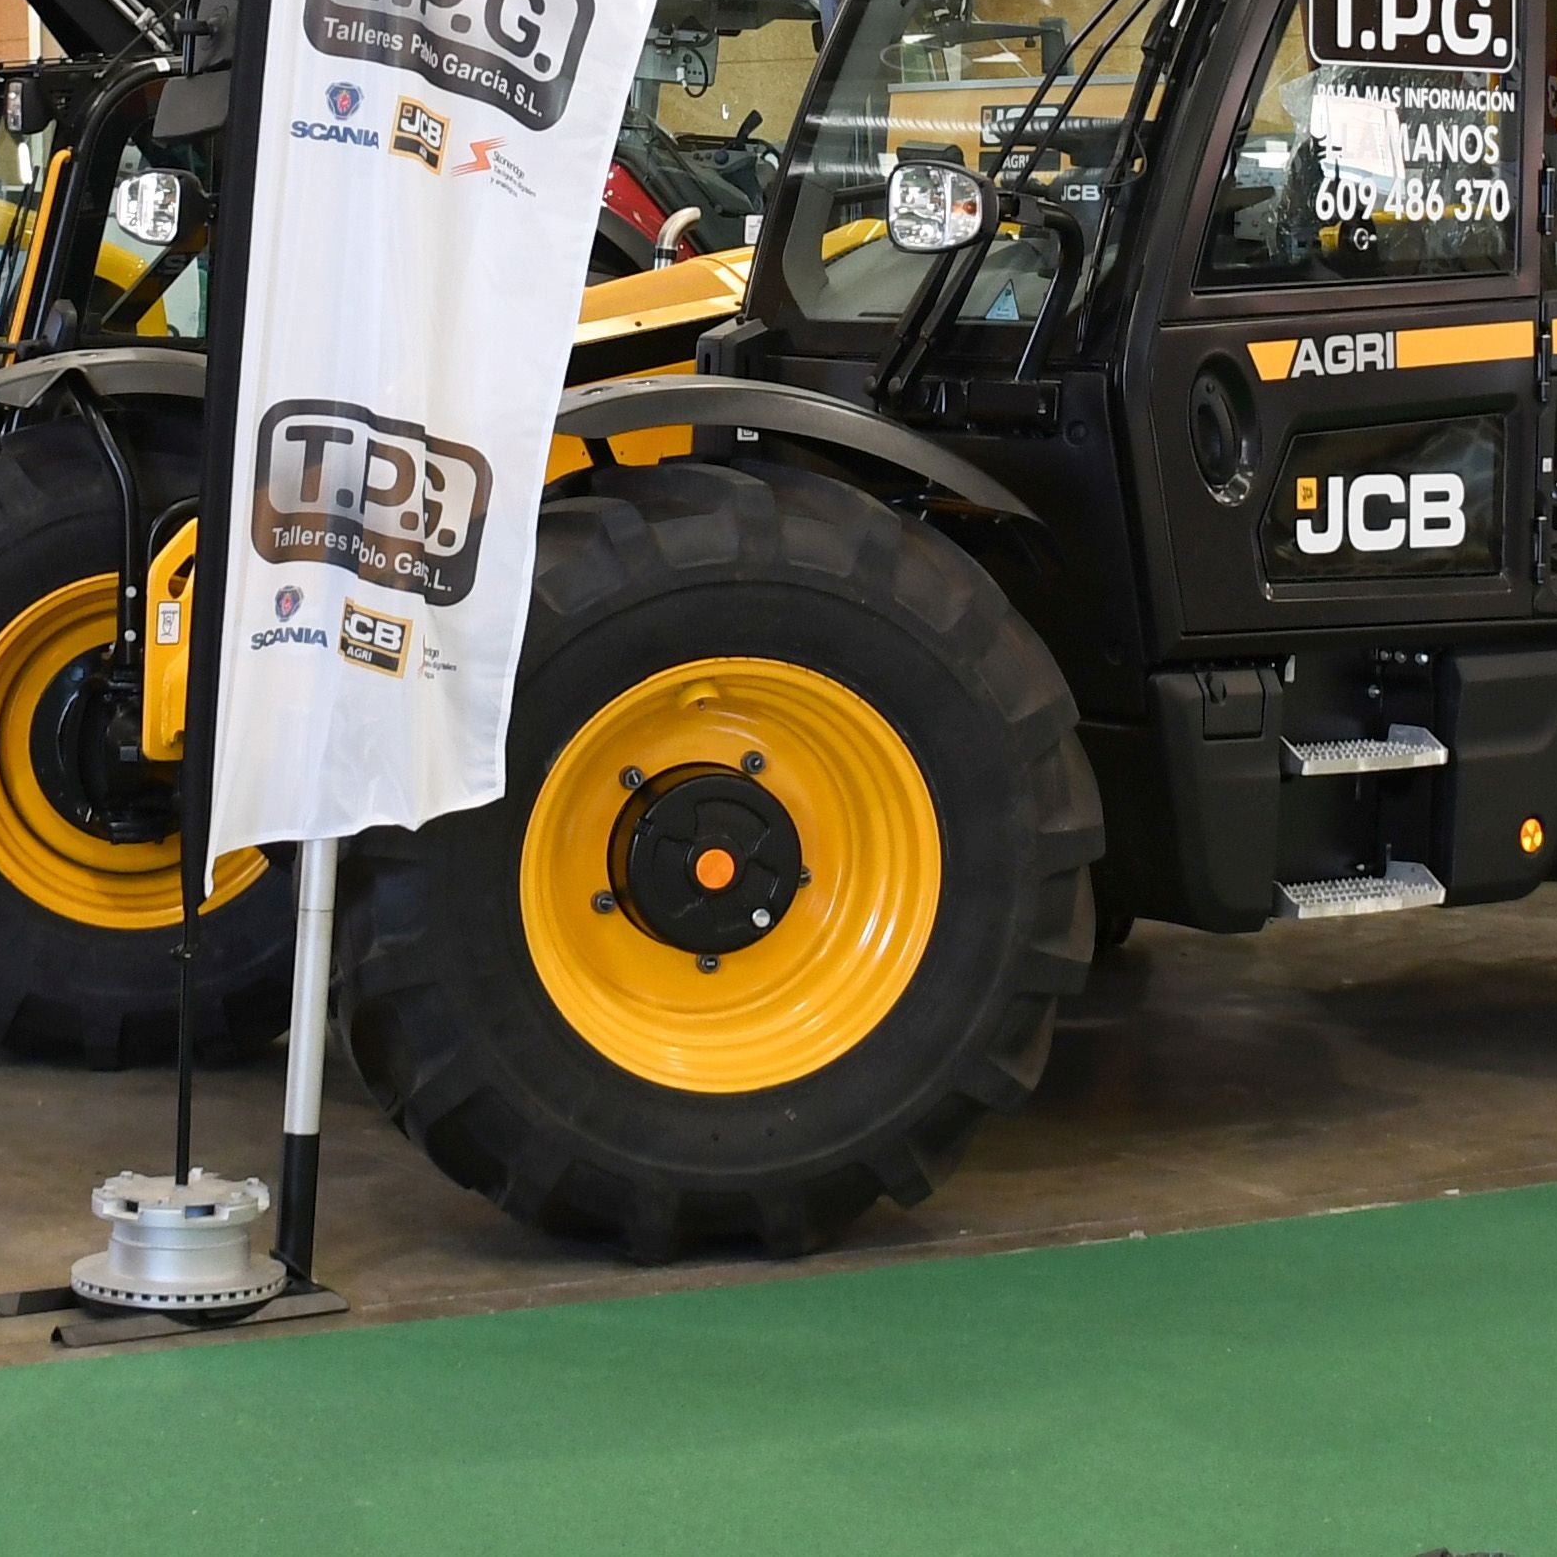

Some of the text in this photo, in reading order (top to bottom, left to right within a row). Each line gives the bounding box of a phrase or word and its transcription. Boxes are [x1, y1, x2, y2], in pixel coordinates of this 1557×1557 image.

[323, 16, 543, 118] Talleres Pablo García, S.L.
[1364, 85, 1401, 109] MAS
[1404, 85, 1516, 113] INFORMACIÓN
[290, 120, 380, 151] SCANIA
[400, 108, 442, 148] JCB
[1061, 184, 1102, 201] JCB
[1315, 177, 1511, 222] 609 486 370
[1290, 331, 1396, 379] AGRI
[1295, 472, 1467, 554] JCB
[272, 526, 348, 554] Talleres
[351, 534, 387, 569] Pblo
[250, 625, 329, 652] SCANIA
[346, 645, 373, 662] AGRI
